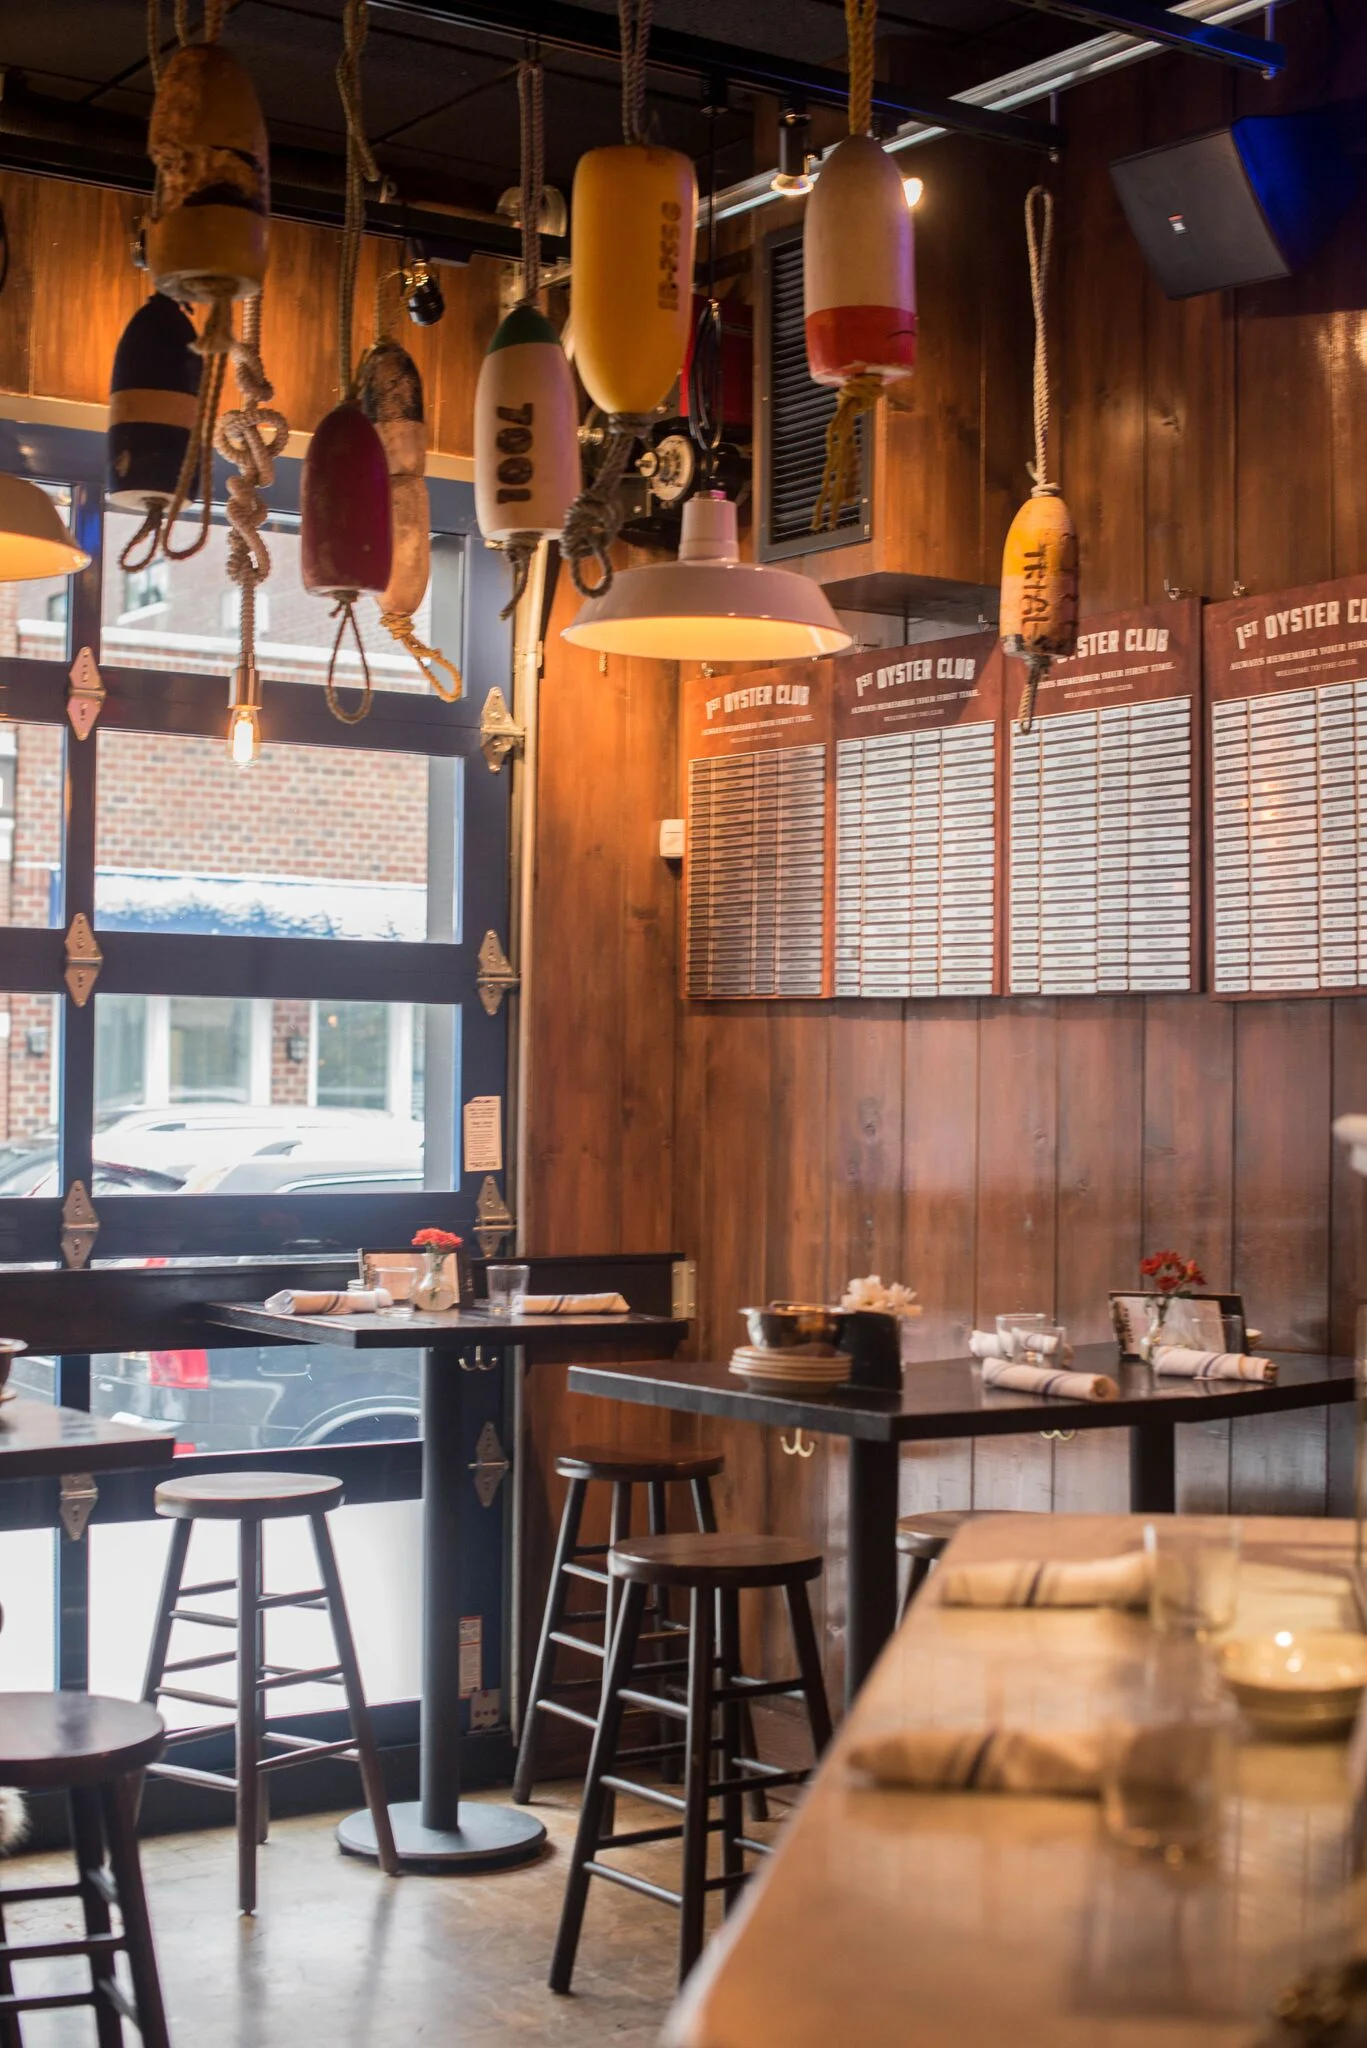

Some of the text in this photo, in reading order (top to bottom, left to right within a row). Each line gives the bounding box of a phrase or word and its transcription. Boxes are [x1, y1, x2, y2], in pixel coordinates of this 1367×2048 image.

[1124, 628, 1170, 653] CLUB
[1236, 620, 1259, 650] 1ST
[1265, 600, 1340, 640] OYSTER
[876, 658, 933, 690] OYSTER
[936, 657, 977, 681] CLUB
[724, 685, 774, 713] OYSTER
[775, 684, 811, 706] CLUB
